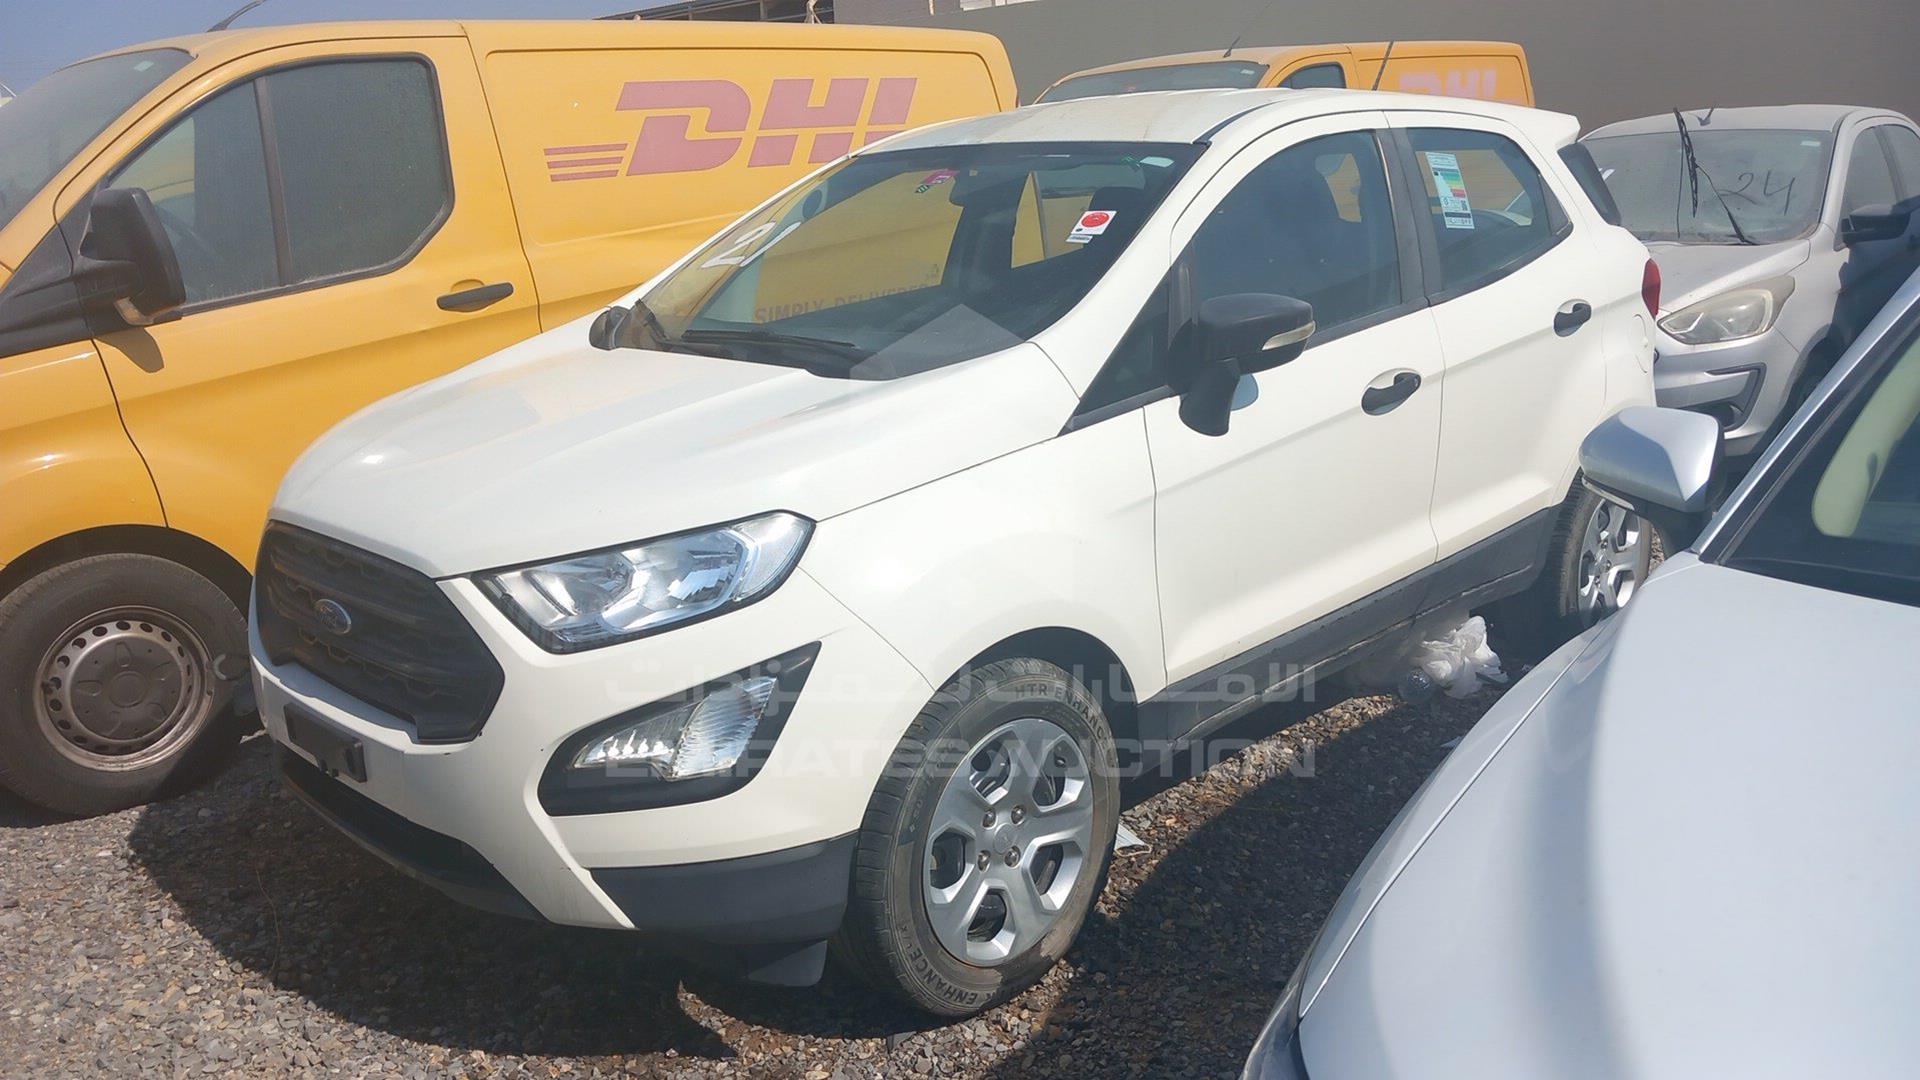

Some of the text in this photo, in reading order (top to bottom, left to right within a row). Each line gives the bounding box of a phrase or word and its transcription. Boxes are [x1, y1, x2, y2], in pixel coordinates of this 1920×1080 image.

[1717, 169, 1796, 216] 24
[1014, 682, 1048, 699] HTR
[909, 948, 979, 1005] ENHANCE
